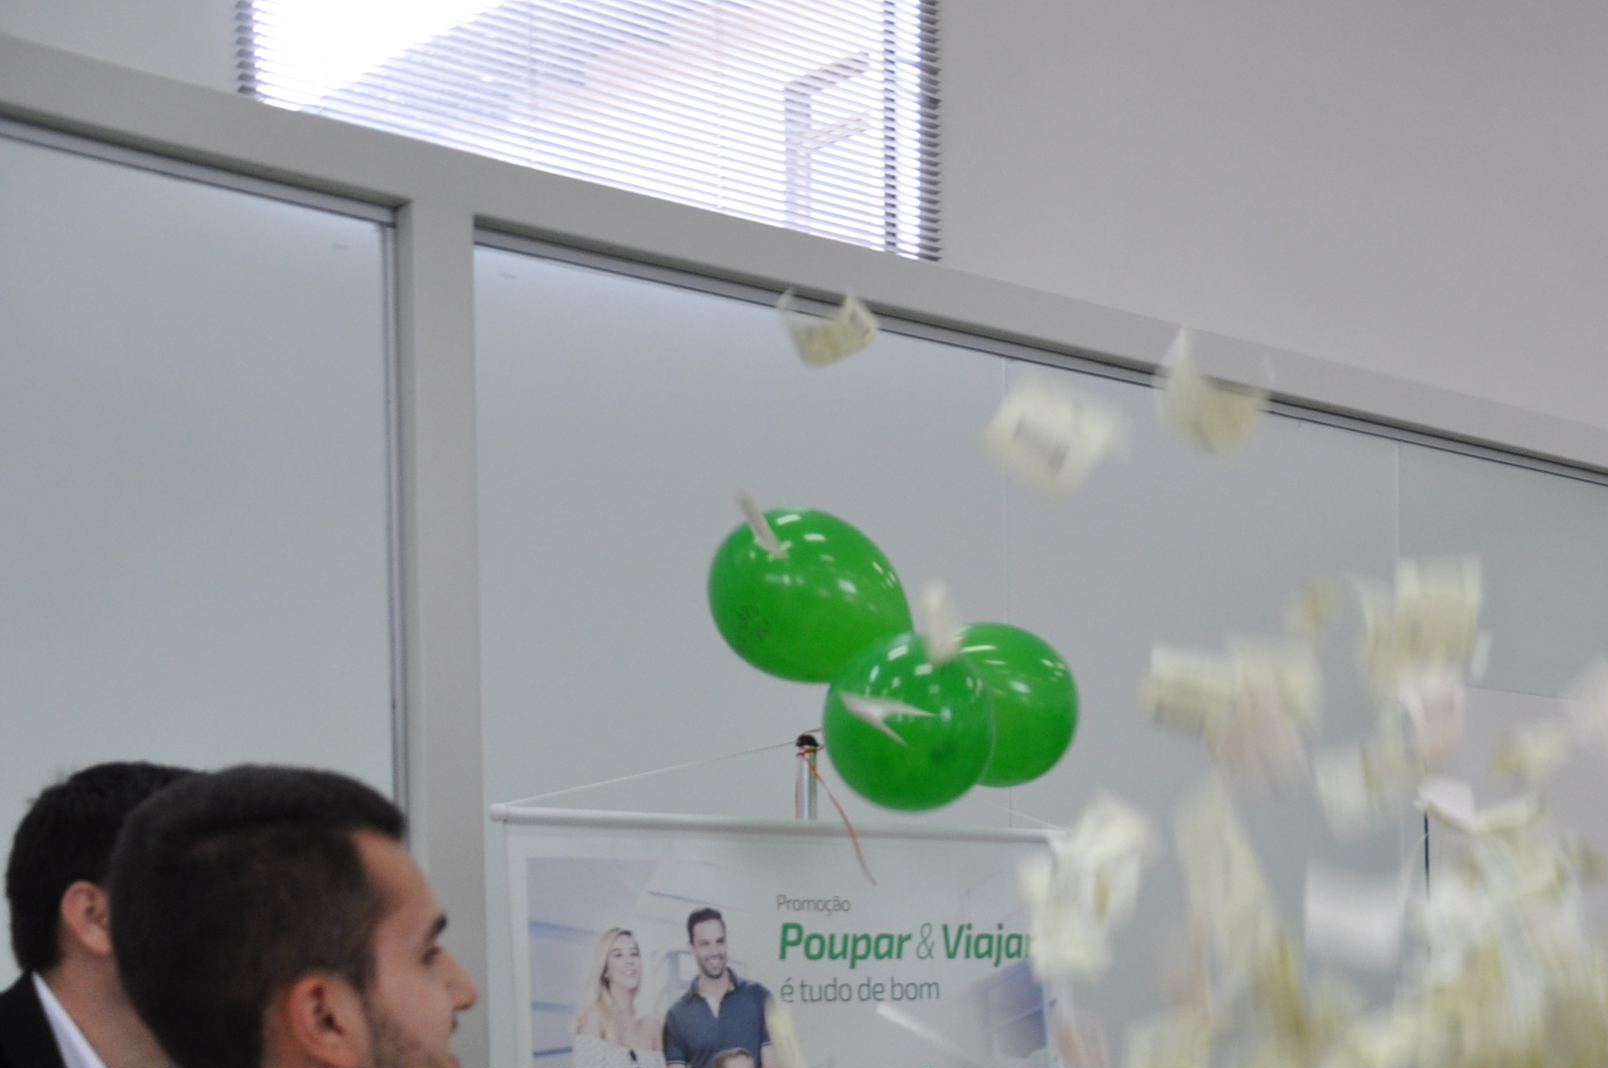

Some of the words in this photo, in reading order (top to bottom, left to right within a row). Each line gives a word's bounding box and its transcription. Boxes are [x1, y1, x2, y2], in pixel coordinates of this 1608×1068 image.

[776, 894, 851, 916] Promoção
[779, 922, 912, 970] Poupar
[916, 922, 935, 960] &
[780, 977, 795, 1002] é
[800, 977, 853, 1002] tudo
[858, 976, 885, 1001] de
[891, 976, 940, 1001] bom
